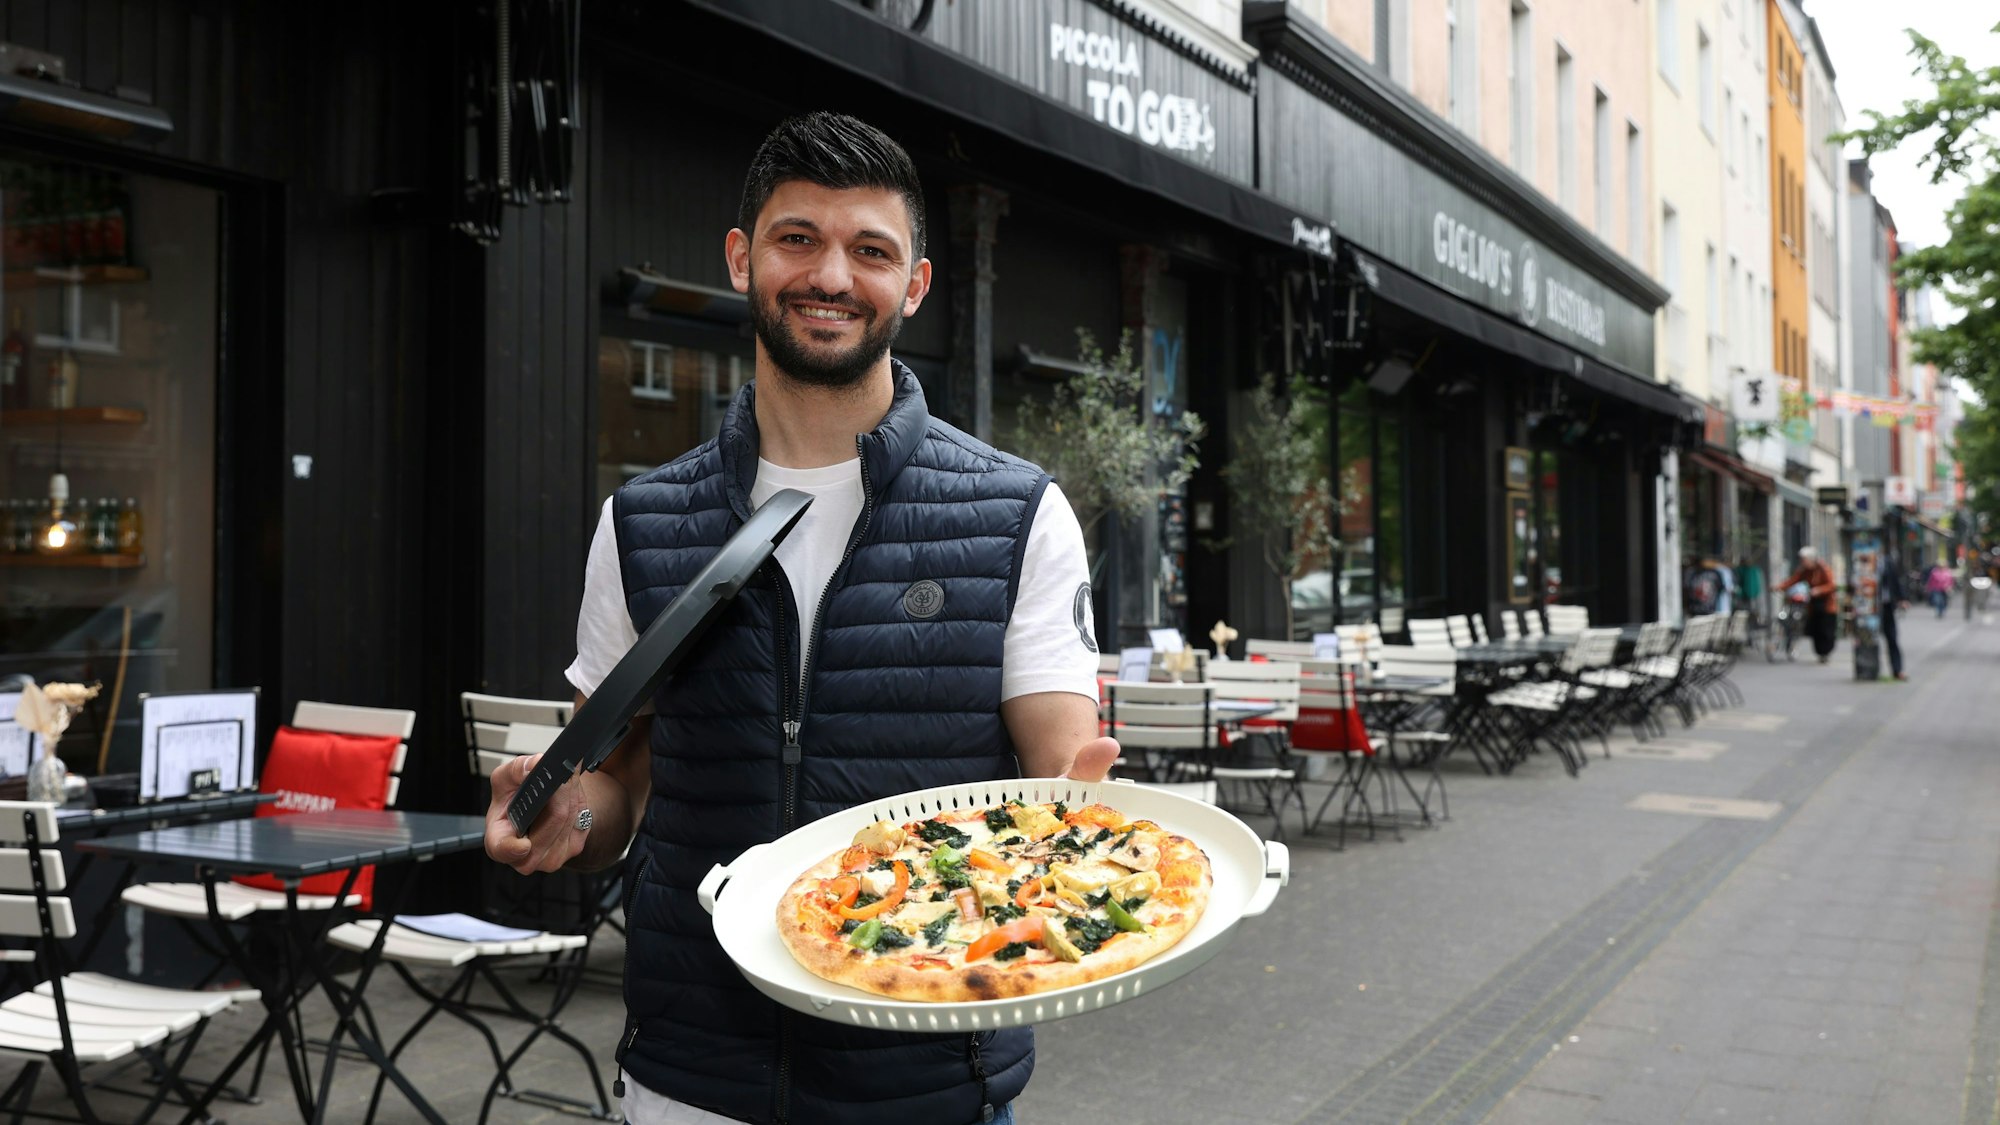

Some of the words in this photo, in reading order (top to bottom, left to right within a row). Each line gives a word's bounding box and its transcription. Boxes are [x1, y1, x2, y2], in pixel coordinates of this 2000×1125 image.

[1050, 23, 1140, 77] PICCOLA
[1087, 80, 1135, 134] TO
[1138, 89, 1182, 149] GO
[274, 789, 336, 813] CAMPARI
